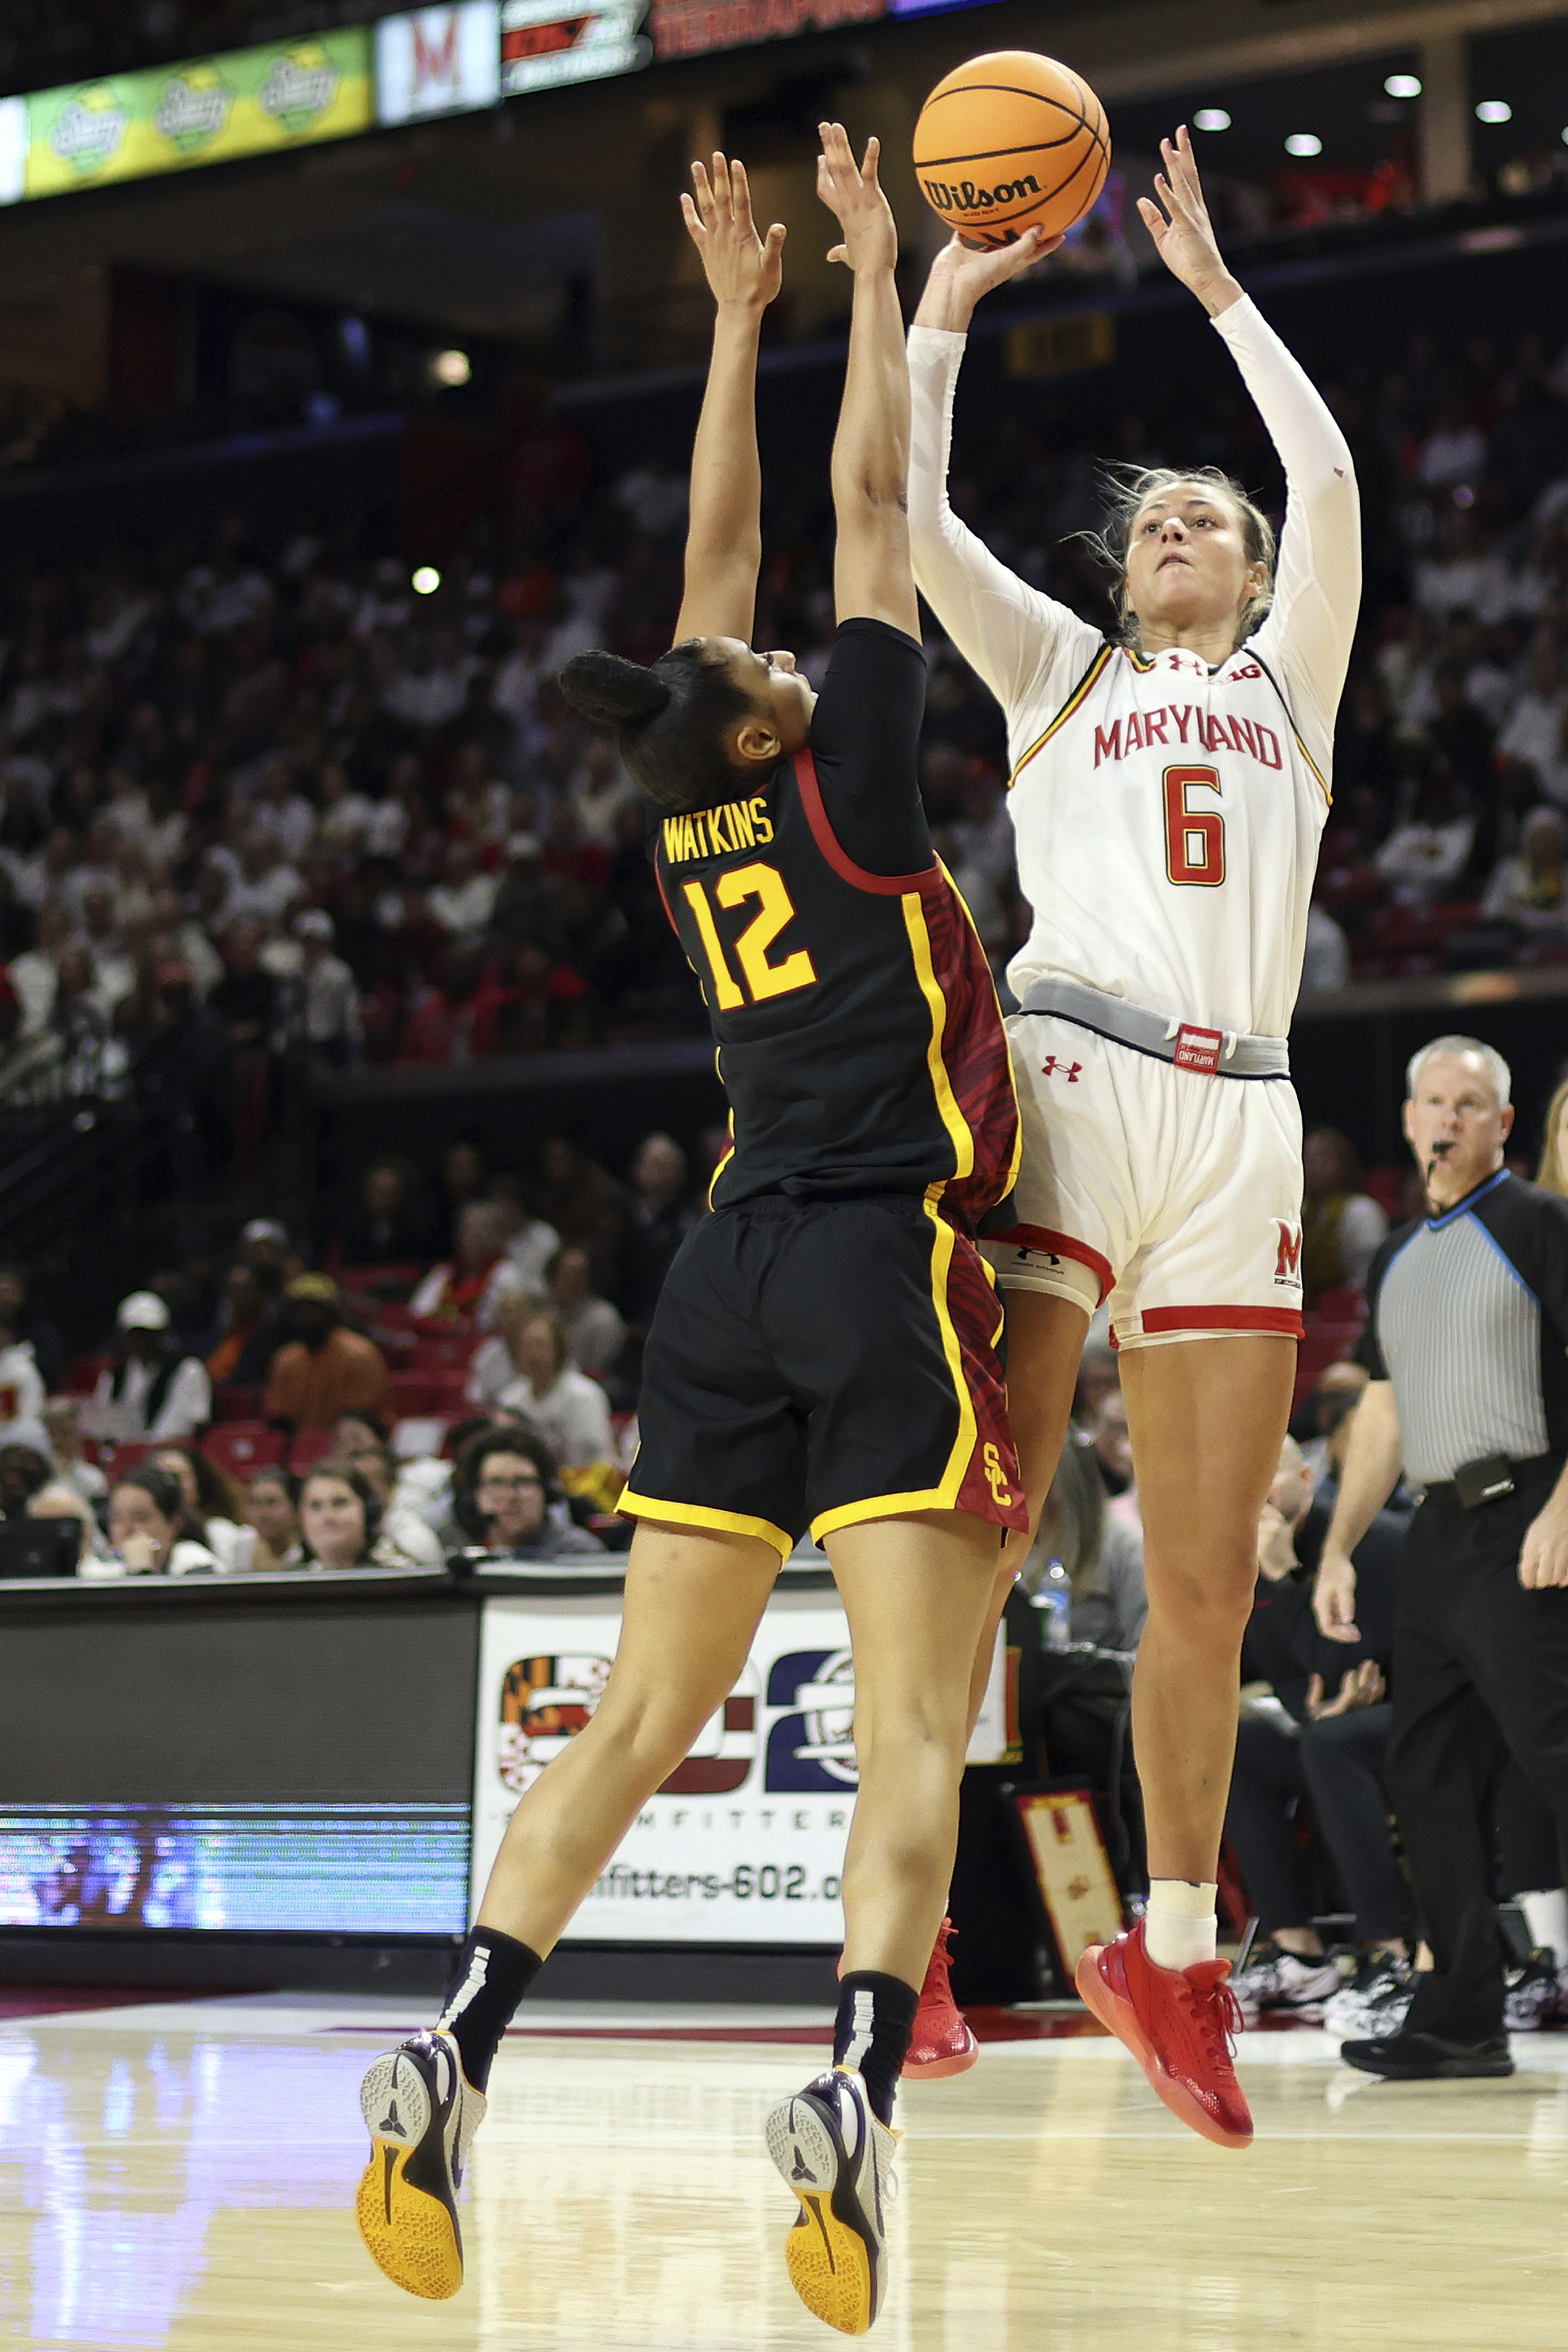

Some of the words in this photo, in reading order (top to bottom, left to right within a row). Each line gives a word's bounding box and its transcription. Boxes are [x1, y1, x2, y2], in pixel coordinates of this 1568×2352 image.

[924, 175, 1043, 211] Wilson
[1093, 704, 1282, 770] MARYLAND
[663, 797, 774, 864] WATKINS
[1162, 764, 1226, 887] 6
[681, 860, 819, 1013] 12
[1179, 1050, 1215, 1066] MARYLAND
[1273, 1220, 1302, 1281] M
